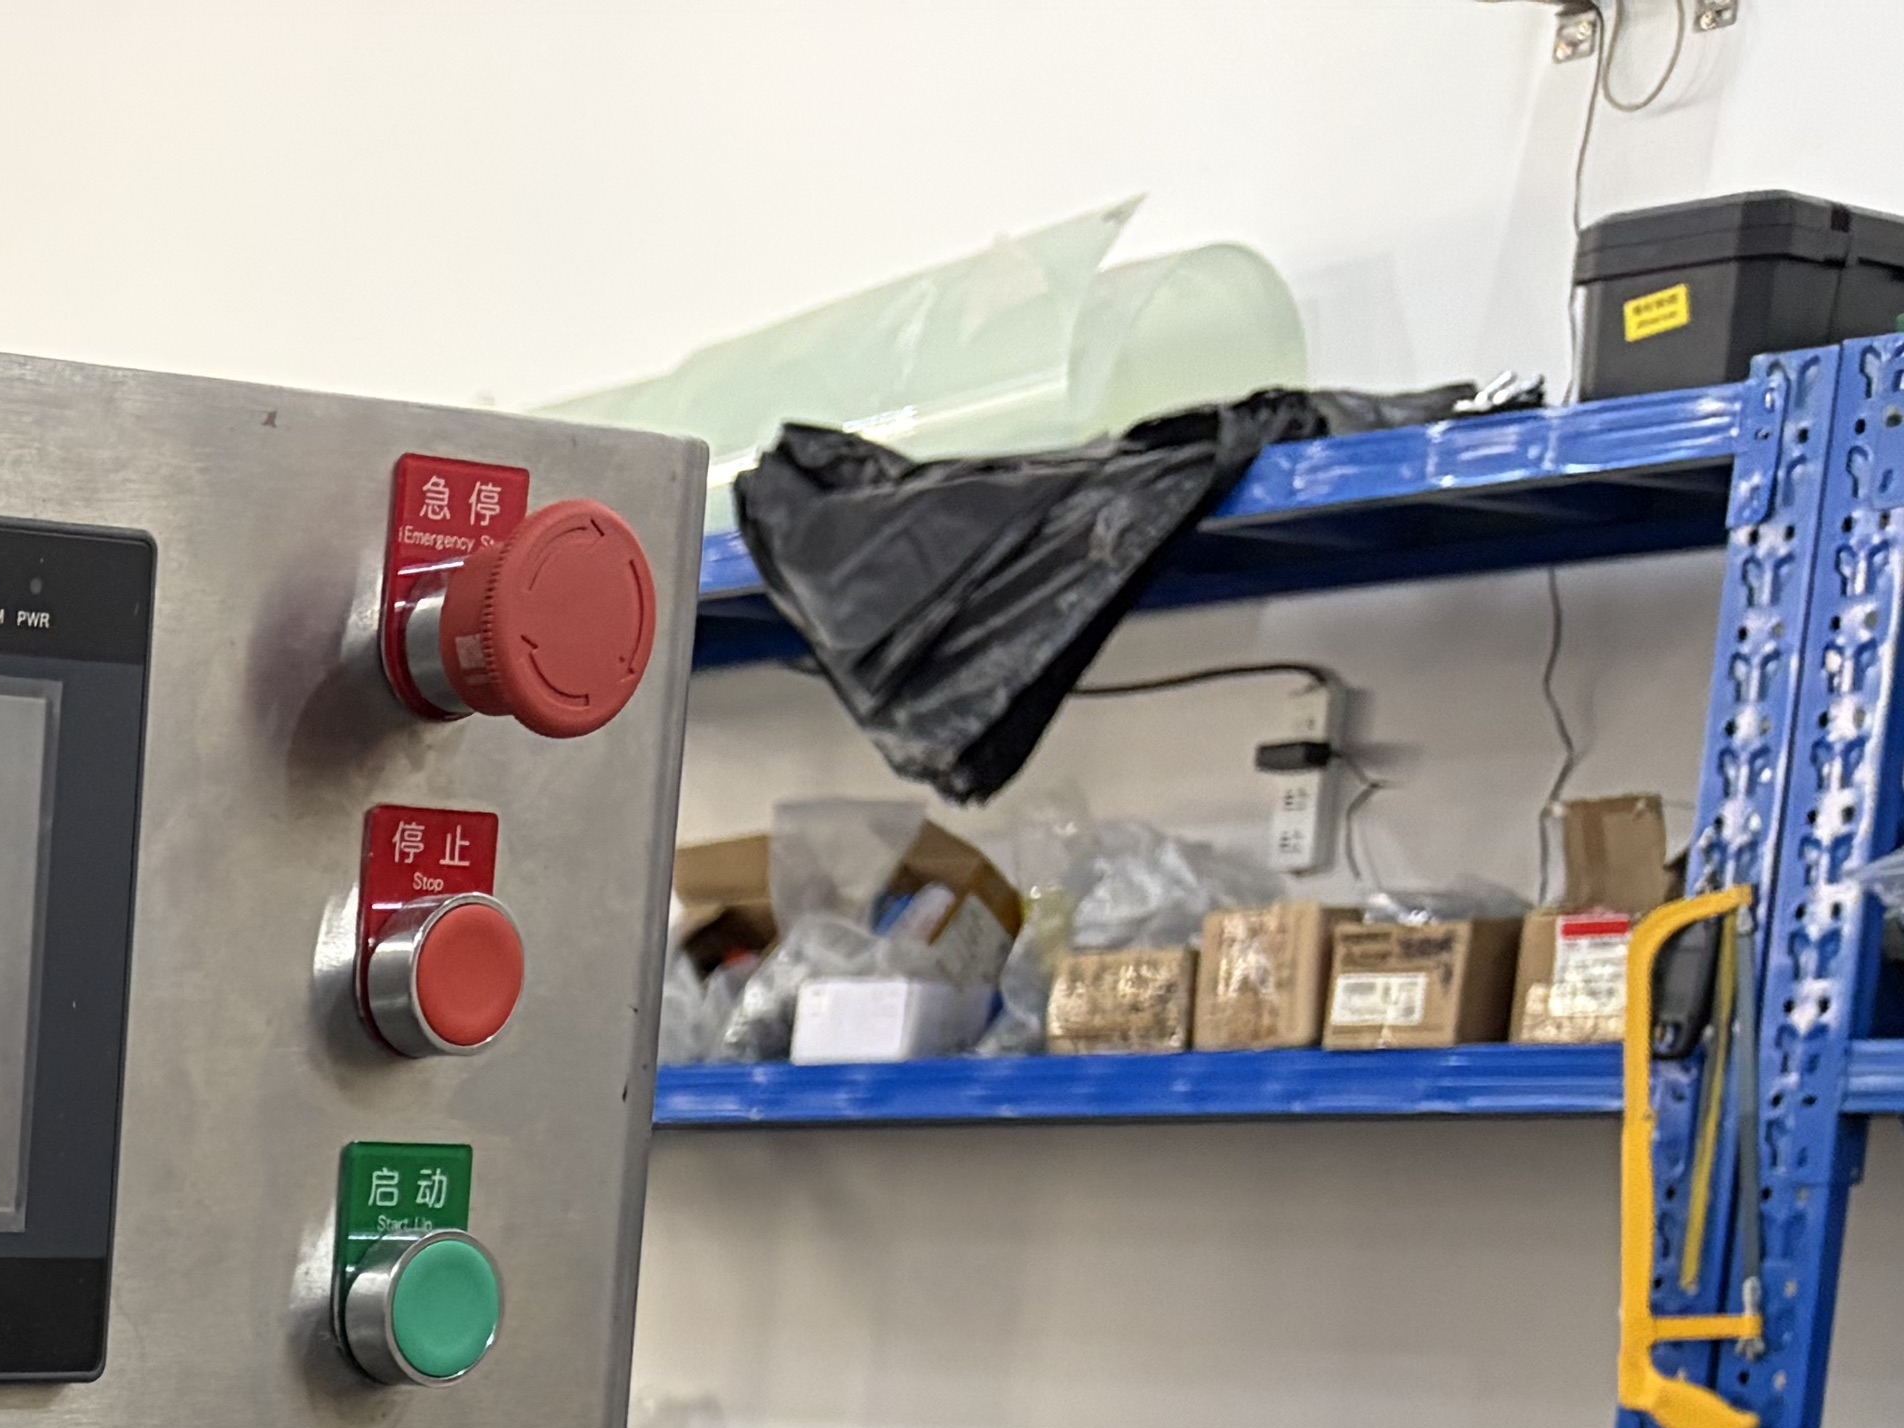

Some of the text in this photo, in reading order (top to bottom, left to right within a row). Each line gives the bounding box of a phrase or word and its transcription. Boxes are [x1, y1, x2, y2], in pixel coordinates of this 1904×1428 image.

[419, 475, 502, 526] 急停
[16, 610, 50, 628] PWR
[392, 820, 471, 866] 停止
[412, 871, 444, 891] Stop
[368, 1167, 448, 1208] 启动
